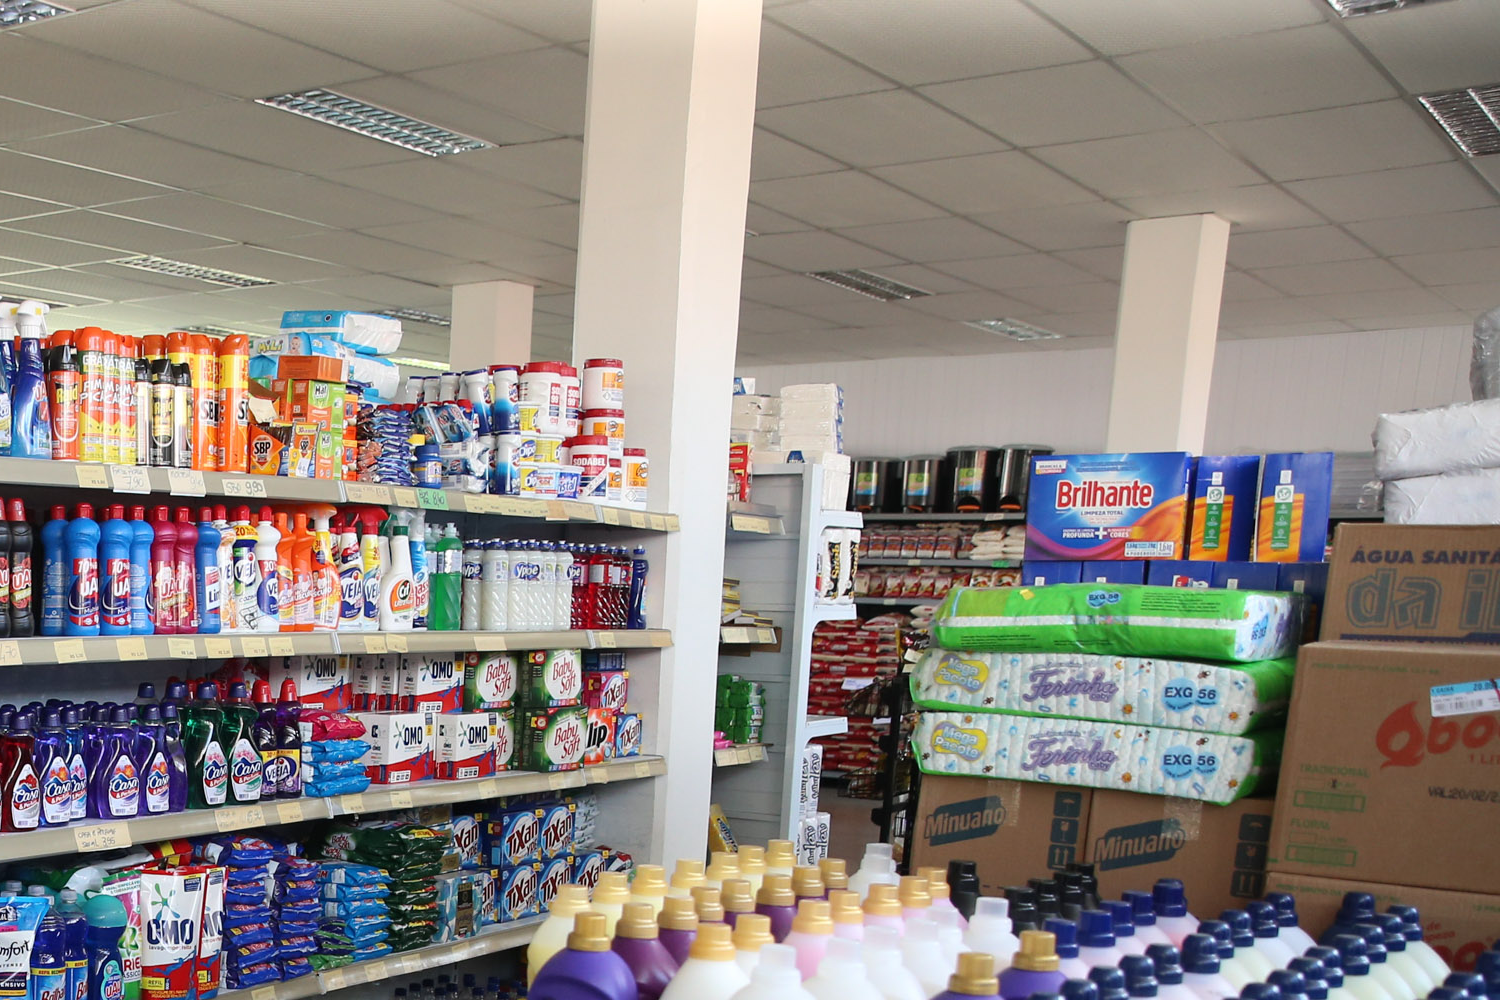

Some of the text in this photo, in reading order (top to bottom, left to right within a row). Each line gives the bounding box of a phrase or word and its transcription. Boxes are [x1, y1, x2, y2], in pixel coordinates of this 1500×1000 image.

[55, 384, 78, 404] Raid
[254, 442, 270, 454] SBP
[573, 457, 606, 466] SODABEL
[1057, 480, 1153, 508] Brilhante
[1352, 545, 1414, 564] ÁGUA
[341, 583, 362, 600] VEJA
[399, 582, 409, 598] Cif
[317, 659, 336, 677] OMO
[431, 660, 453, 679] OMO
[485, 657, 510, 685] Baby
[553, 655, 577, 682] Baby
[946, 656, 979, 676] Mega
[492, 673, 512, 697] Soft
[560, 671, 576, 694] Soft
[937, 668, 981, 689] Pacote
[1164, 686, 1217, 699] EXG 56
[404, 726, 423, 746] OMO
[469, 725, 488, 745] OMO
[554, 723, 579, 749] Baby
[942, 724, 978, 745] Mega
[562, 735, 581, 759] Soft
[934, 736, 981, 757] Pacote
[1163, 754, 1216, 767] EXG 56
[206, 766, 228, 781] Casa
[234, 764, 262, 779] Casa
[1300, 764, 1370, 778] TRADICIONAL
[46, 782, 70, 797] Casa
[111, 779, 139, 794] Casa
[149, 775, 170, 792] Casa
[15, 790, 39, 803] Casa
[925, 803, 1007, 837] Minuano
[1097, 827, 1185, 859] Minuano
[147, 918, 194, 945] OMO
